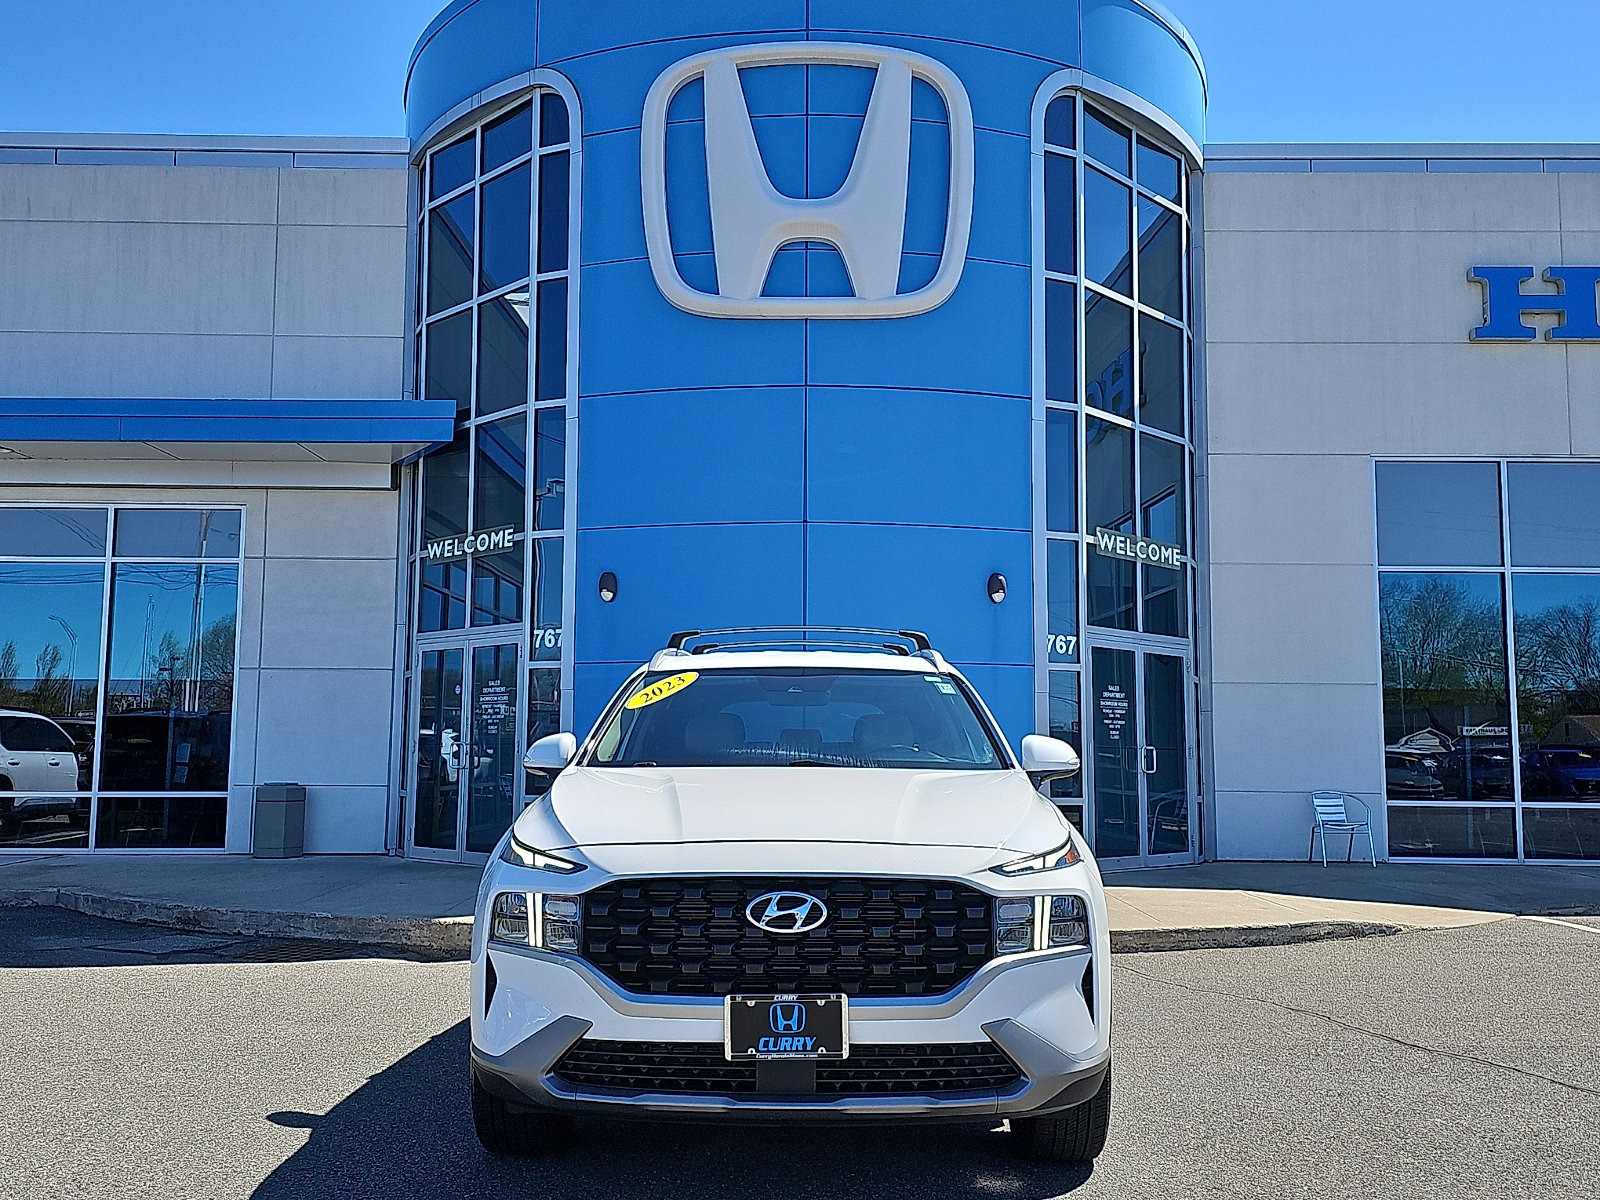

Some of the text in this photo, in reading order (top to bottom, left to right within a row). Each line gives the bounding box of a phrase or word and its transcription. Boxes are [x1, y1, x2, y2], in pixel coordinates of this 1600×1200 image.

[427, 529, 514, 559] WELCOME
[1097, 531, 1181, 566] WELCOME
[533, 629, 563, 648] 767
[1047, 635, 1077, 655] 767
[639, 676, 686, 703] 2023
[758, 1036, 817, 1051] CURRY
